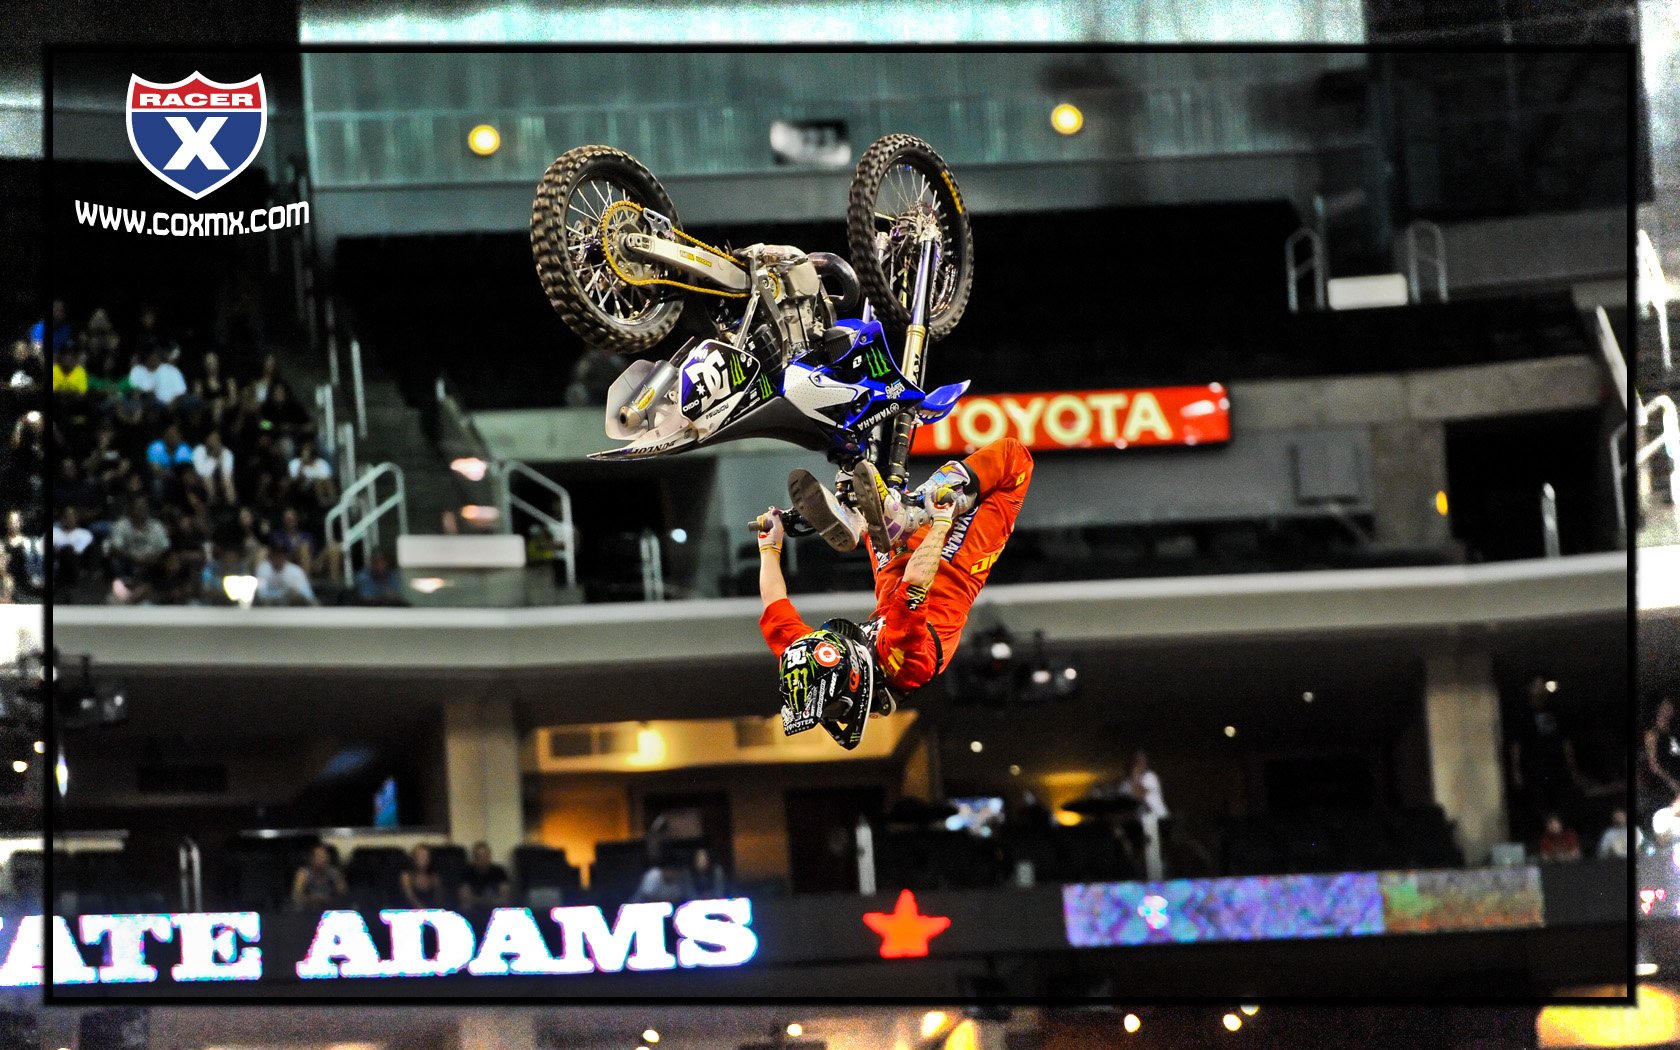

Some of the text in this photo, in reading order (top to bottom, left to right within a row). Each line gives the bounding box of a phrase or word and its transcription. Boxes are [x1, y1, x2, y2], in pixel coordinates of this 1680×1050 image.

[856, 407, 891, 431] YAMAHA
[933, 391, 1174, 451] TOYOTA
[0, 897, 759, 987] ATE ADAMS
